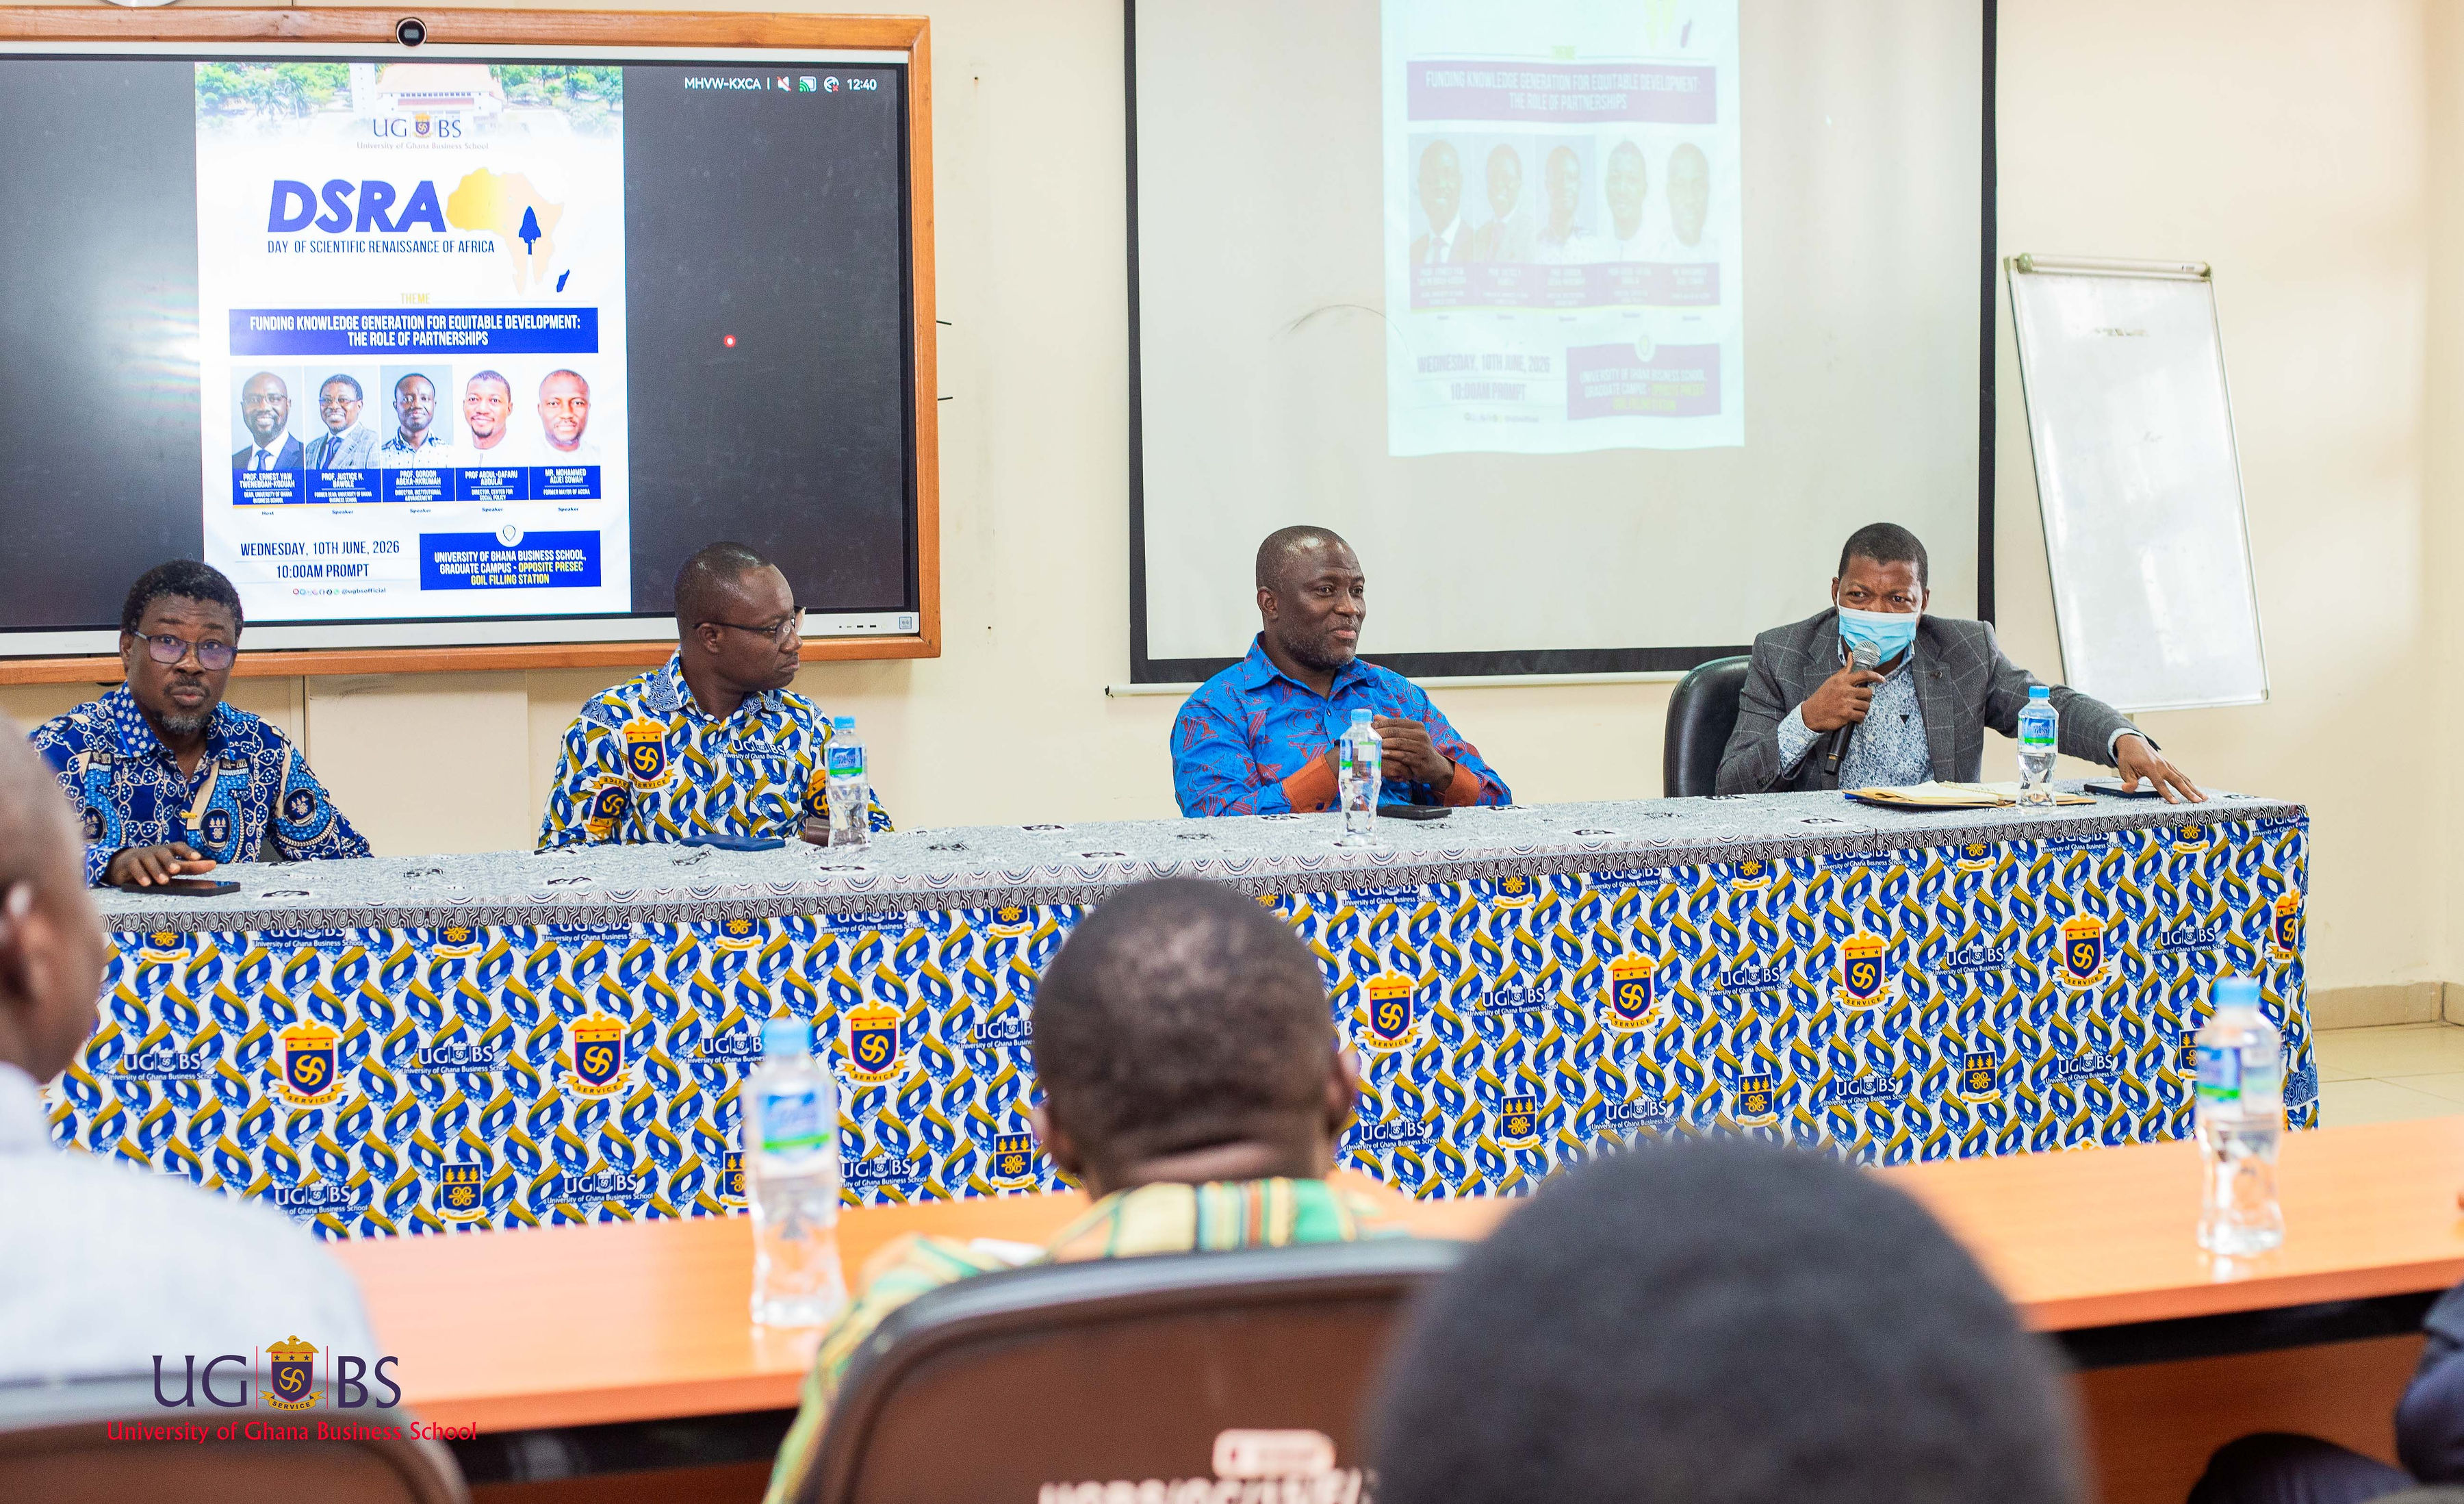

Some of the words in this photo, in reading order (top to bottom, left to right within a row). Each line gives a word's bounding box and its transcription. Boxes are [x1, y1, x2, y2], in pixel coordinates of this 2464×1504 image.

[684, 77, 761, 90] MHVW-KXCA
[847, 78, 877, 91] 12:40
[1426, 71, 1465, 88] FUNDING
[1467, 71, 1519, 89] KNOWLEDGE
[1521, 72, 1571, 90] GENERATION
[1574, 73, 1589, 90] FOR
[1591, 73, 1639, 90] EQUITABLE
[1509, 92, 1524, 109] THE
[1526, 92, 1547, 110] ROLE
[1549, 93, 1560, 110] OF
[1561, 93, 1628, 110] PARTNERSHIPS
[372, 119, 407, 138] UG
[439, 119, 462, 138] BS
[357, 142, 394, 150] University
[465, 141, 489, 149] School
[268, 179, 447, 233] DSRA
[268, 240, 287, 253] DAY
[294, 240, 307, 253] OF
[310, 240, 365, 253] SCIENTIFIC
[369, 240, 439, 253] RENAISSANCE
[443, 240, 455, 253] OF
[459, 240, 495, 253] AFRICA
[400, 293, 431, 305] THEME
[251, 316, 295, 331] FUNDING
[297, 315, 359, 331] KNOWLEDGE
[361, 315, 425, 330] GENERATION
[427, 315, 446, 330] FOR
[448, 314, 503, 329] EQUITABLE
[506, 314, 580, 329] DEVELOPMENT:
[348, 331, 367, 347] THE
[370, 331, 396, 346] ROLE
[398, 331, 411, 346] OF
[413, 331, 489, 346] PARTNERSHIPS
[241, 542, 308, 557] WEDNESDAY,
[313, 541, 338, 555] 10TH
[342, 541, 370, 555] JUNE,
[373, 540, 400, 554] 2026
[434, 550, 479, 563] UNIVERSITY
[480, 550, 489, 562] OF
[491, 550, 517, 561] GHANA
[518, 550, 554, 561] BUSINESS
[555, 549, 587, 561] SCHOOL,
[277, 565, 323, 578] 10:00AM
[326, 563, 370, 578] PROMPT
[439, 563, 479, 574] GRADUATE
[480, 562, 512, 574] CAMPUS
[518, 561, 553, 573] OPPOSITE
[555, 561, 584, 572] PRESEC
[489, 574, 517, 585] FILLING
[518, 573, 549, 585] STATION
[2068, 976, 2099, 985] SERVICE
[1482, 991, 1507, 1007] UG
[1528, 987, 1545, 1004] BS
[1846, 997, 1882, 1006] SERVICE
[1467, 1009, 1495, 1017] University
[1614, 1018, 1650, 1027] SERVICE
[1373, 1038, 1409, 1047] SERVICE
[418, 1047, 448, 1064] UG
[472, 1046, 493, 1062] BS
[123, 1054, 155, 1071] UG
[179, 1054, 201, 1070] BS
[401, 1067, 431, 1075] University
[854, 1072, 895, 1080] SERVICE
[107, 1074, 137, 1082] University
[577, 1085, 617, 1094] SERVICE
[287, 1095, 332, 1103] SERVICE
[564, 1176, 593, 1194] UG
[617, 1174, 637, 1192] BS
[548, 1196, 577, 1204] University
